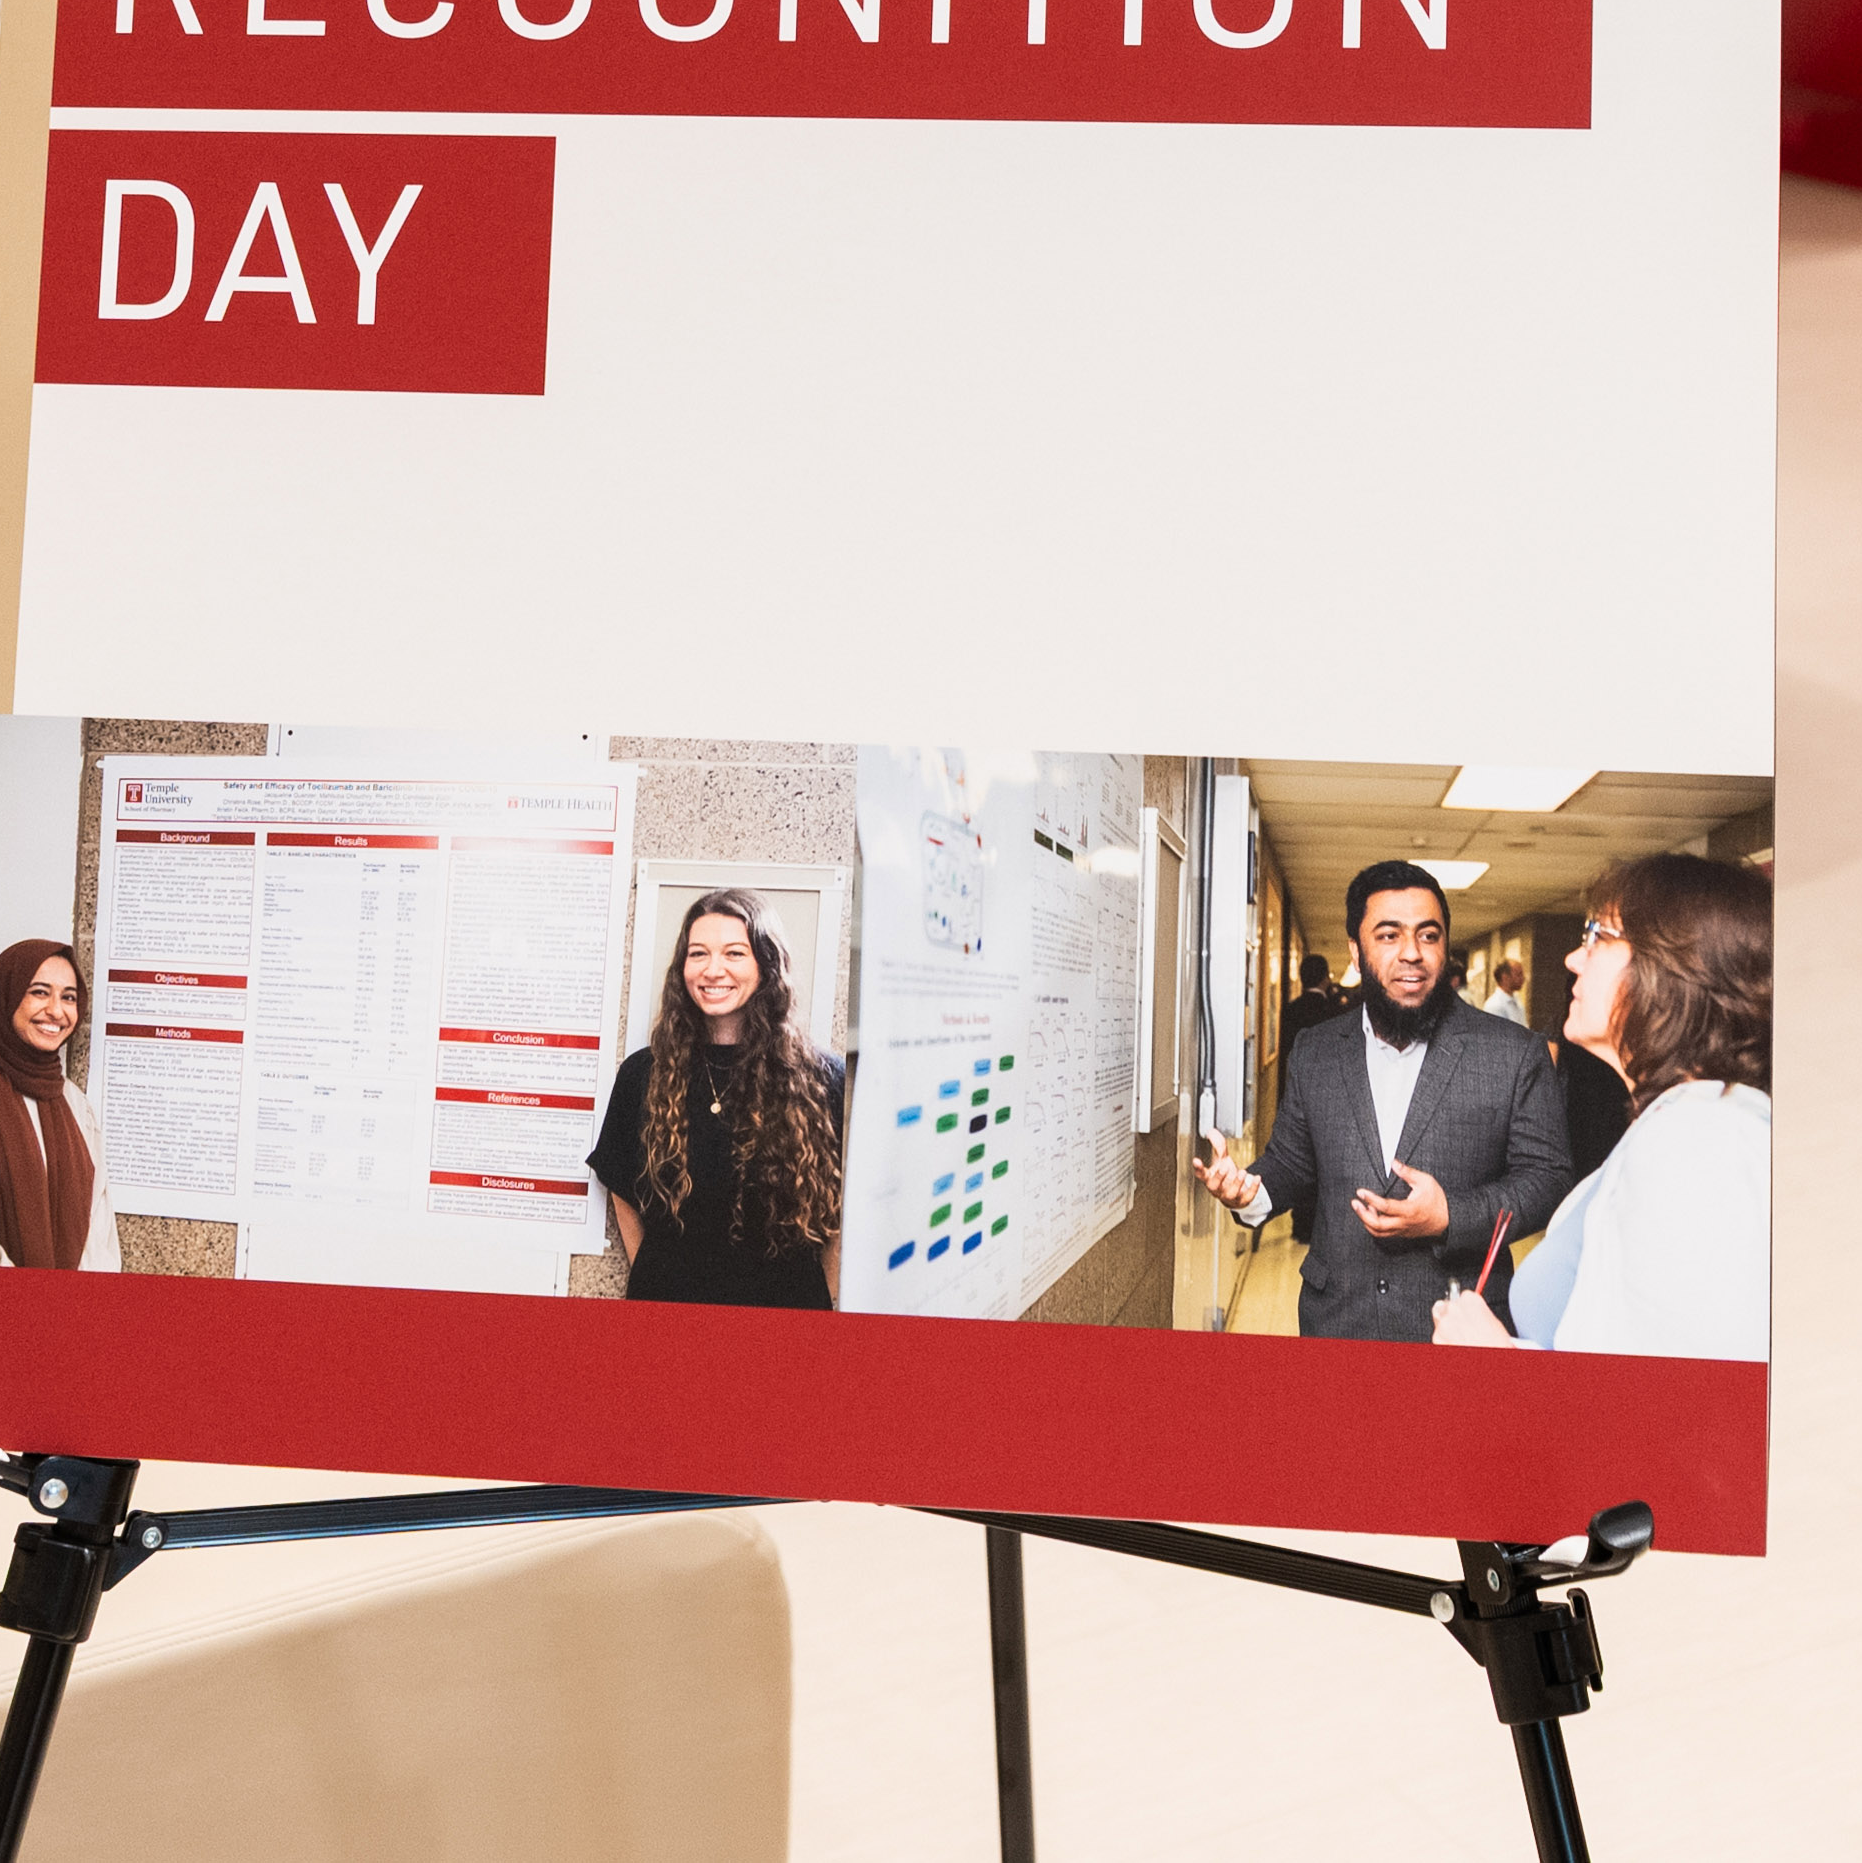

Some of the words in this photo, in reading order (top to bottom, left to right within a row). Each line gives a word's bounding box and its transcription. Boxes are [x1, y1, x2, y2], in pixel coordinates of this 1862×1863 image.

[96, 178, 425, 327] DAY
[145, 783, 180, 794] Temple
[223, 781, 246, 790] Safety
[265, 782, 295, 791] Efficacy
[145, 794, 194, 807] University
[160, 832, 211, 844] Background
[334, 836, 368, 847] Results
[154, 973, 199, 985] Objectives
[155, 1028, 192, 1039] Methods
[492, 1032, 545, 1045] Conclusion
[488, 1092, 541, 1106] References
[481, 1176, 536, 1191] Disclosures
